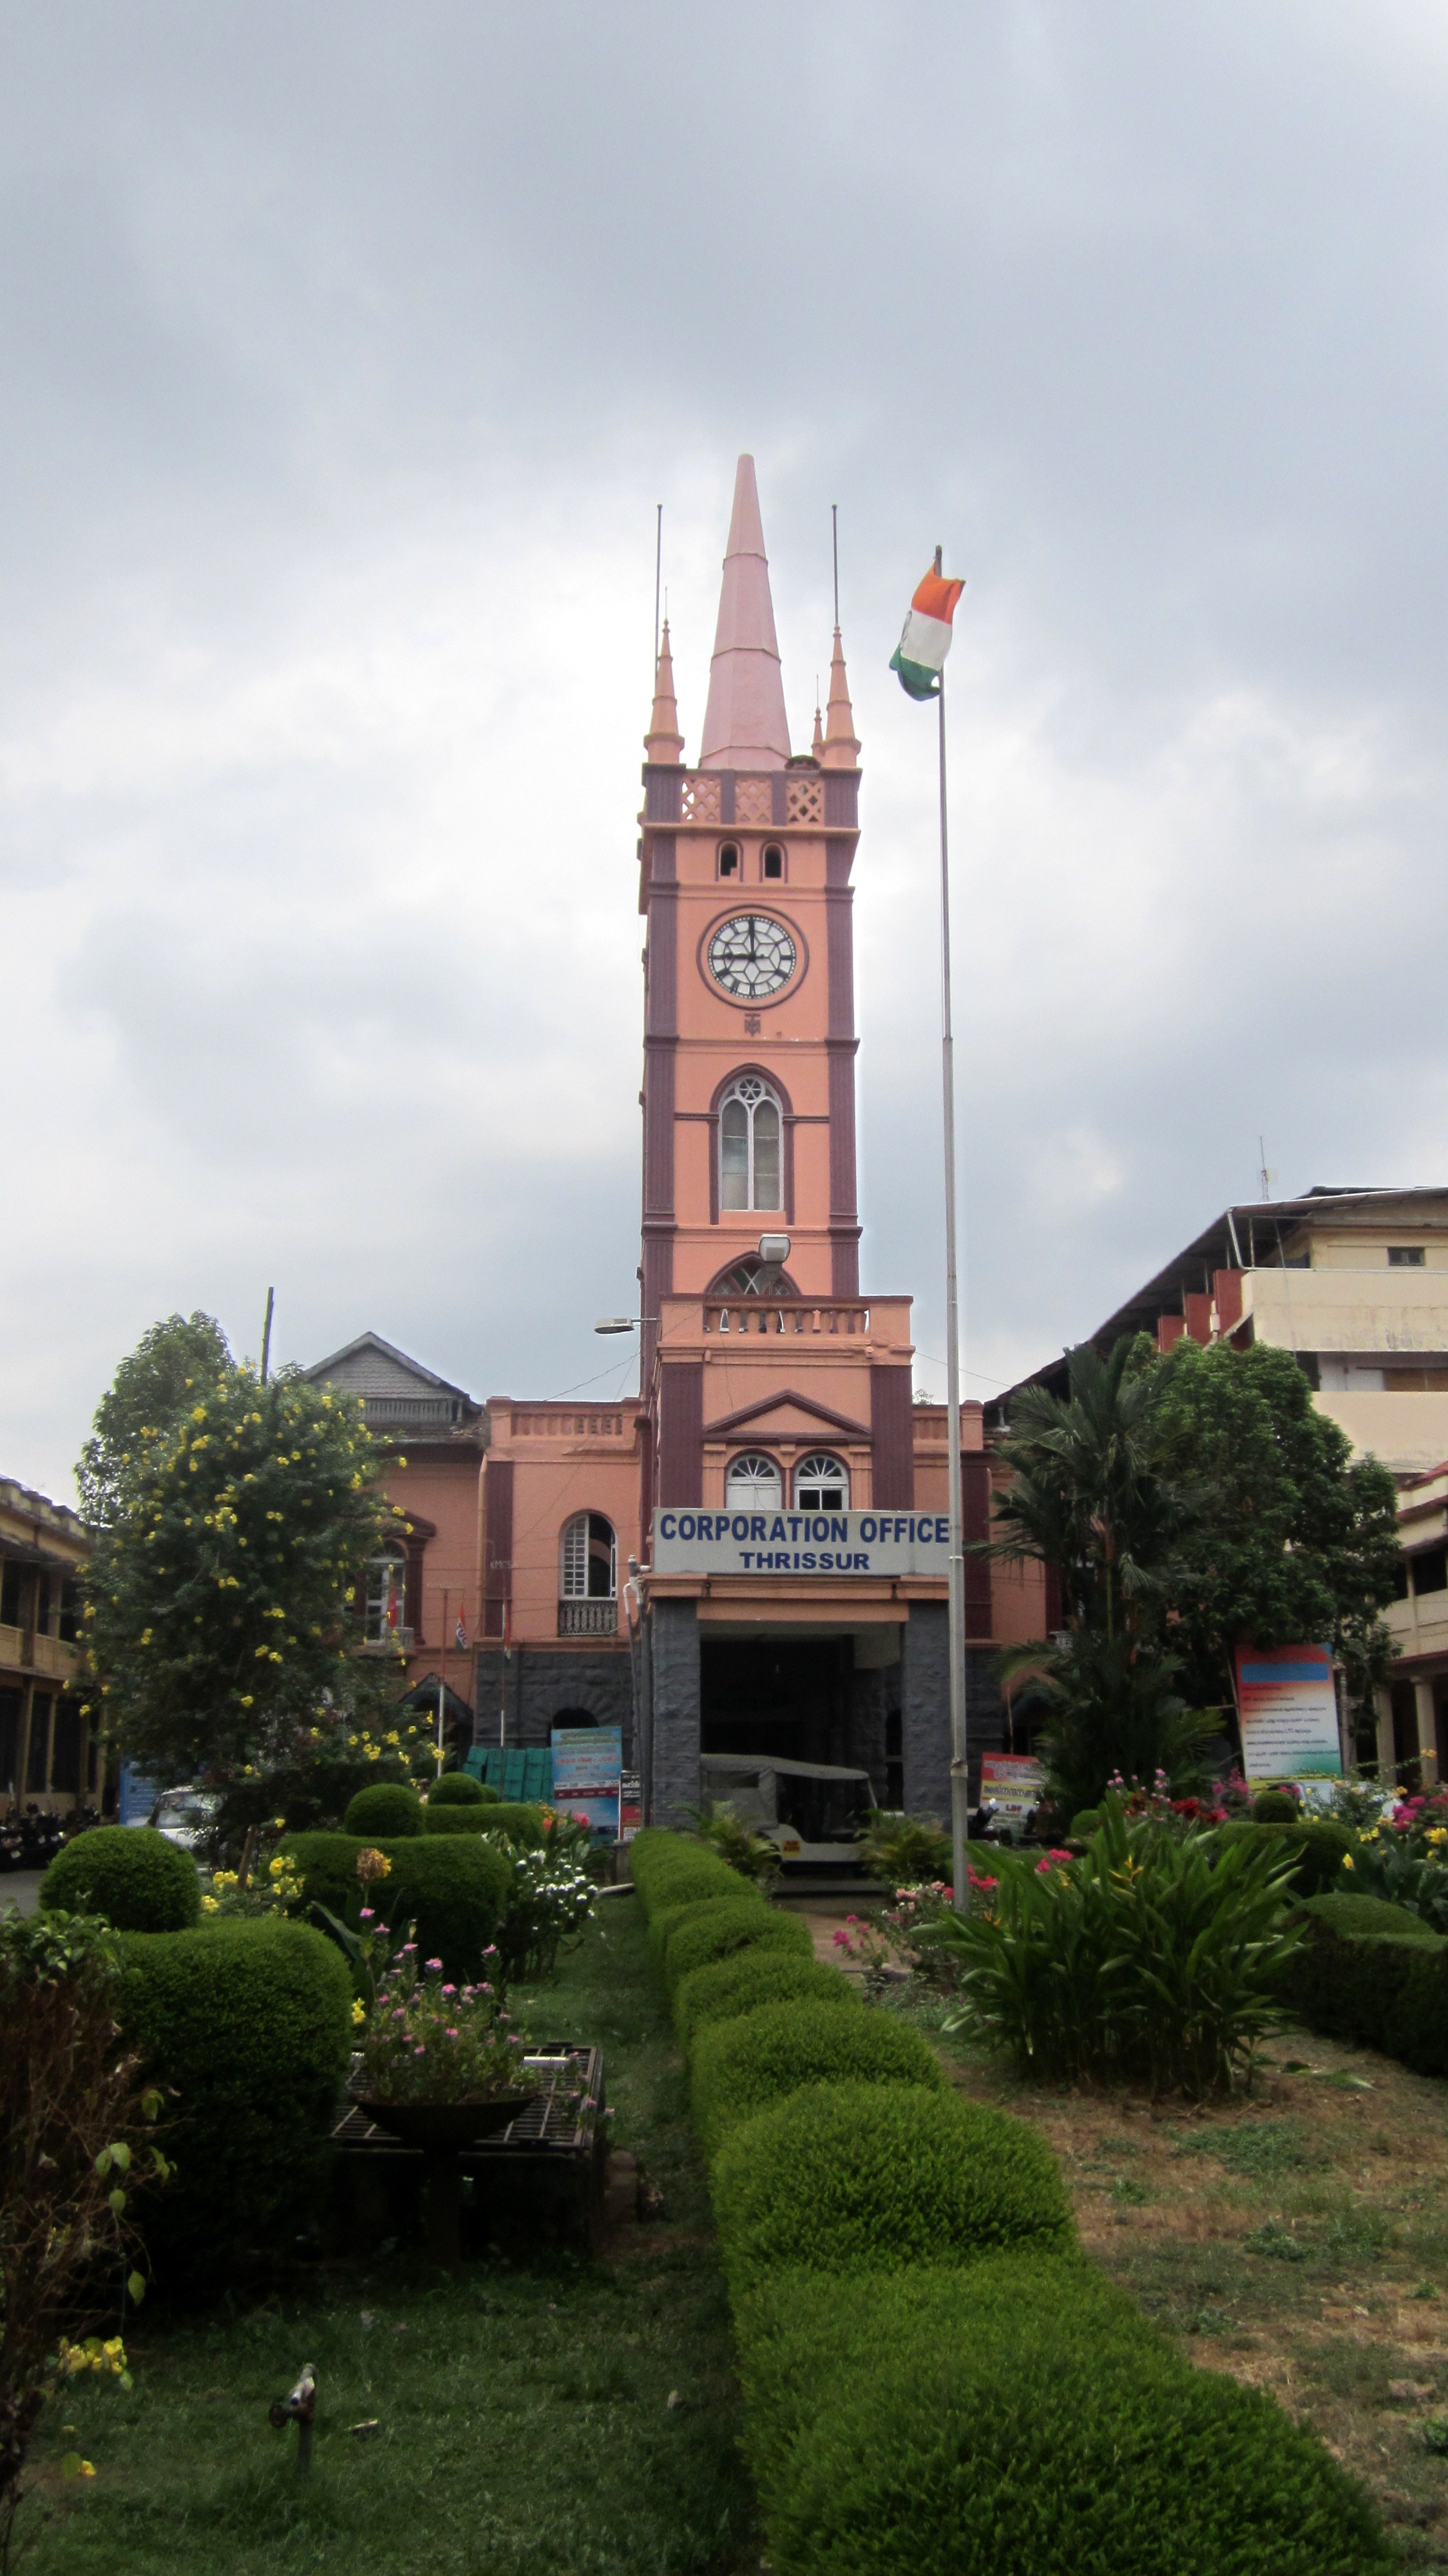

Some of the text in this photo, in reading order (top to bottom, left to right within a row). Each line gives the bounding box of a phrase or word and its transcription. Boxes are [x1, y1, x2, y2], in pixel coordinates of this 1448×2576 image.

[661, 1515, 949, 1543] CORPORATION OFFICE
[739, 1552, 870, 1569] THRISSUR
